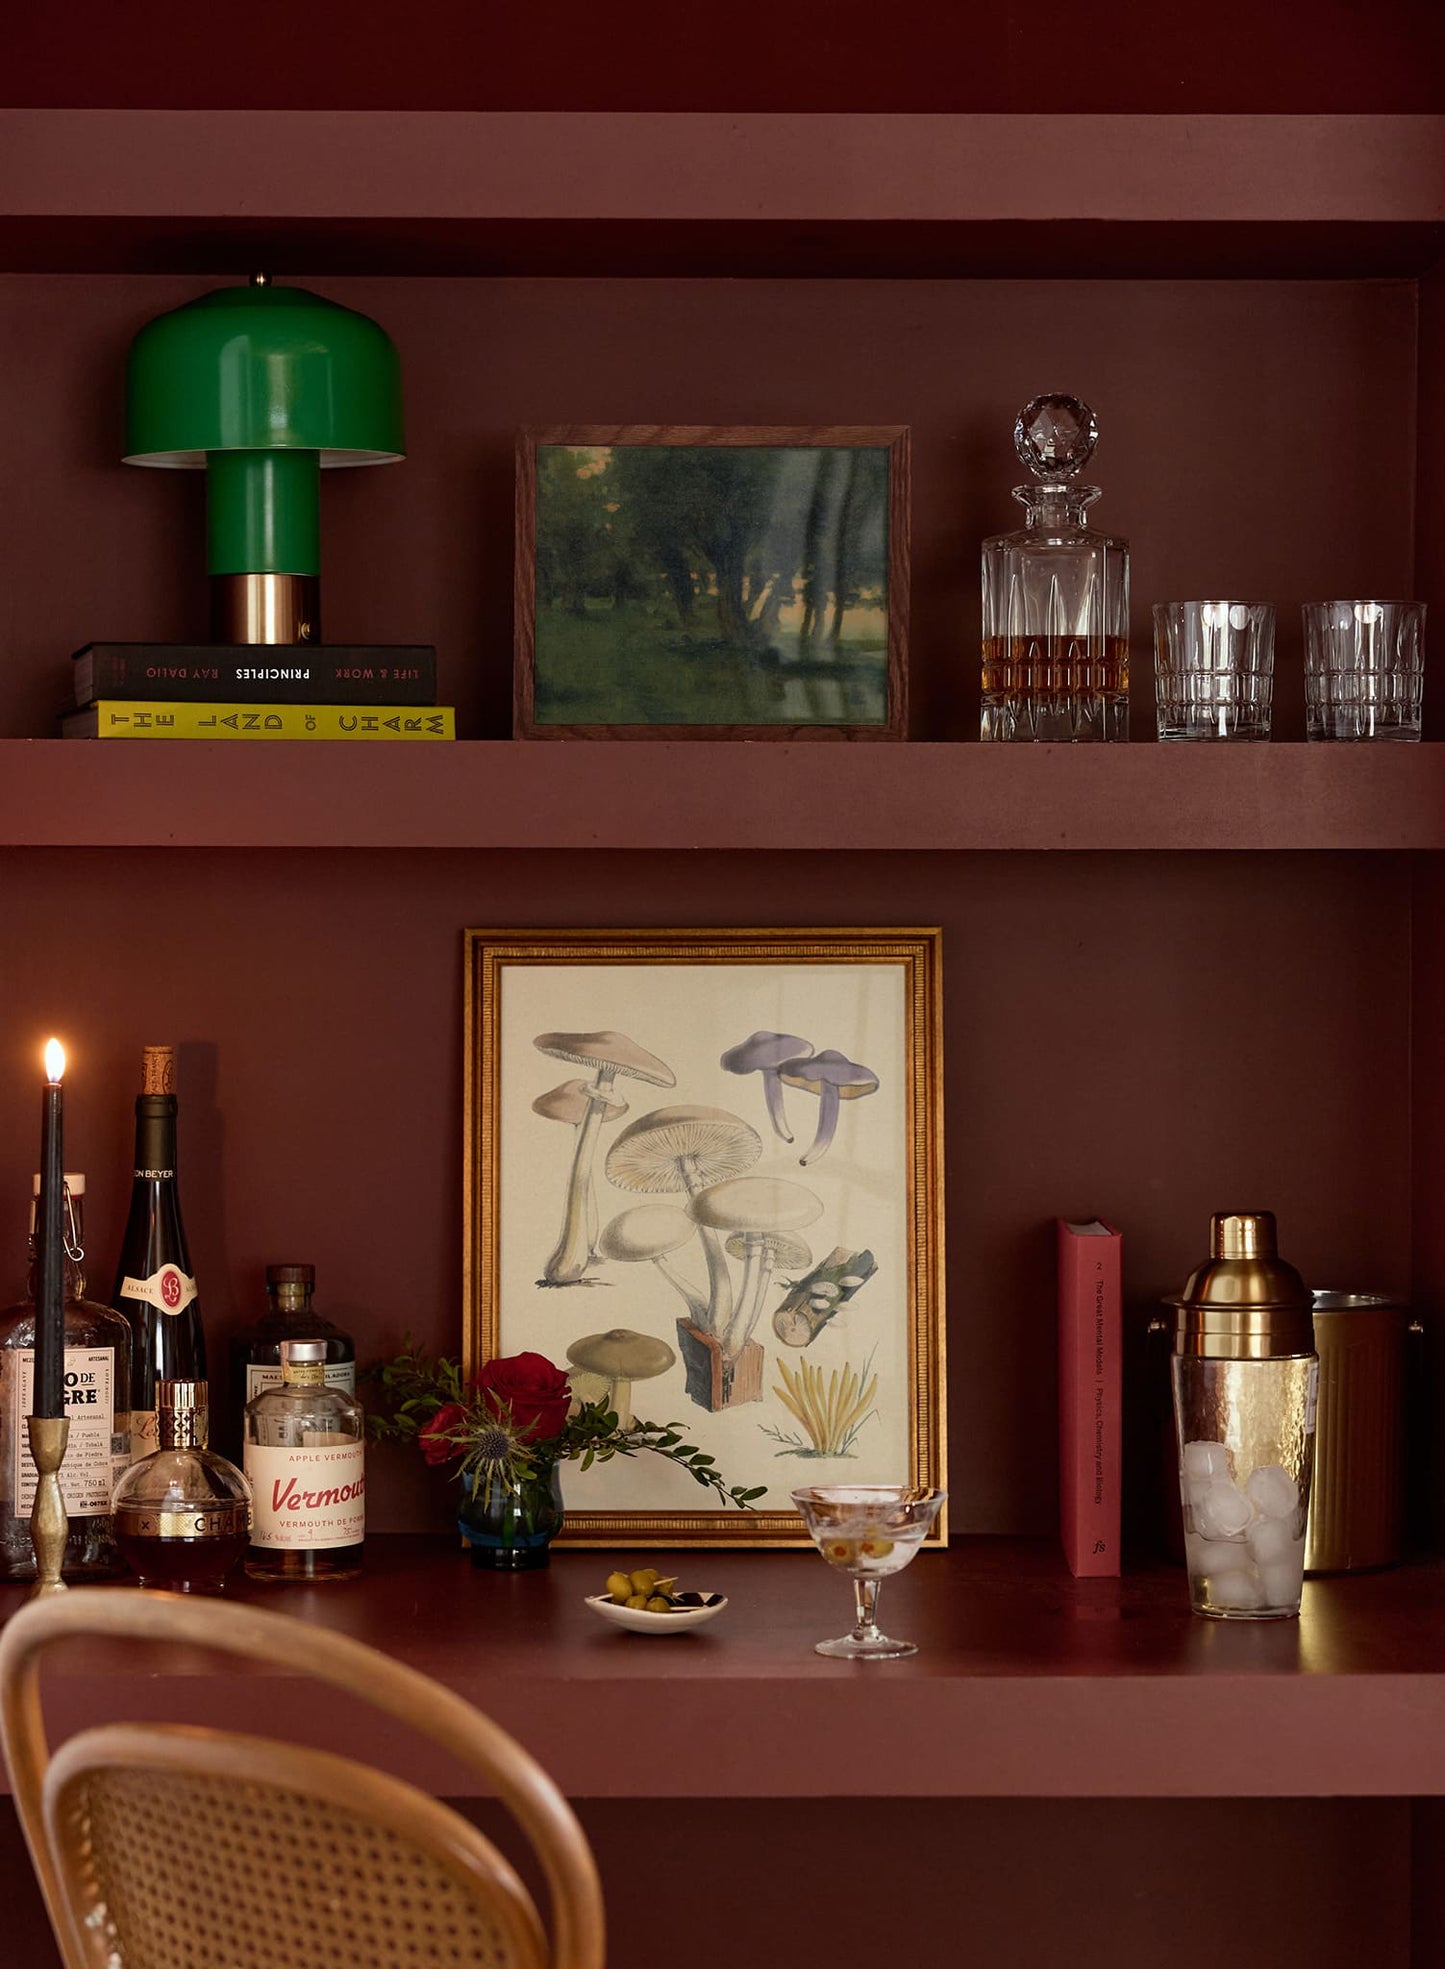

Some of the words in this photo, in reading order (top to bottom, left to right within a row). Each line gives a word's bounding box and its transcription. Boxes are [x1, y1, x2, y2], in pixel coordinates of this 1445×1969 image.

[146, 667, 187, 678] DALIO
[193, 668, 218, 679] RAY
[236, 668, 310, 680] PRINCIPLES
[335, 668, 374, 679] WORK
[380, 668, 389, 678] &
[393, 668, 419, 679] LIFE
[111, 712, 174, 728] THE
[198, 713, 282, 730] LAND
[305, 714, 317, 731] OF
[339, 714, 444, 735] CHARM
[145, 1169, 174, 1178] BEYER
[1096, 1279, 1104, 1294] The
[1096, 1295, 1104, 1317] Great
[1096, 1318, 1104, 1345] Mental
[1096, 1346, 1104, 1375] Models
[80, 1373, 96, 1383] DE
[1095, 1420, 1104, 1459] Chemistry
[1096, 1460, 1104, 1476] and
[84, 1479, 97, 1487] 750
[1095, 1477, 1104, 1504] Biology
[280, 1520, 334, 1528] VERMOUTH
[1093, 1540, 1106, 1554] fs
